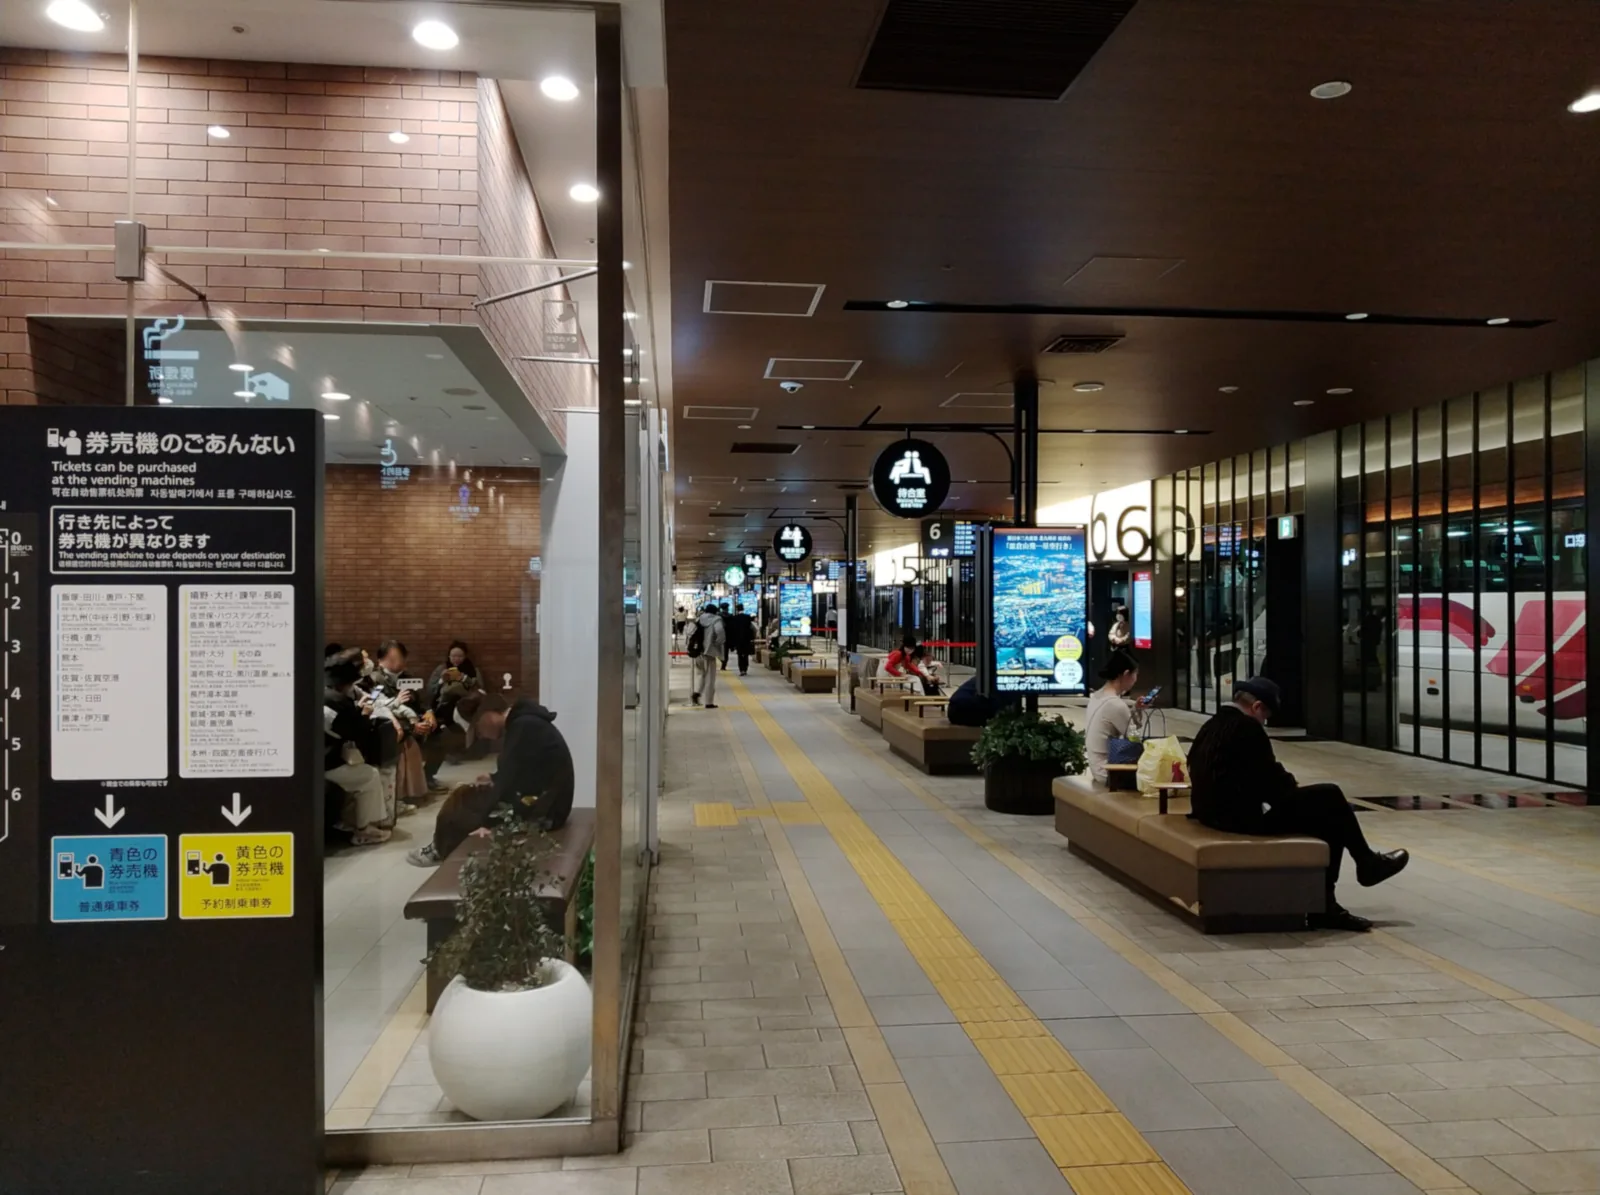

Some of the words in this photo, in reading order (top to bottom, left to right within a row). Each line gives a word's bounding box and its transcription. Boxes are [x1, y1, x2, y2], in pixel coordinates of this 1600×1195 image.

[86, 432, 295, 455] 券売機のごあんない
[52, 461, 92, 472] Tickets
[95, 464, 115, 472] can
[119, 461, 134, 472] be
[138, 461, 197, 474] purchased
[52, 476, 64, 485] at
[67, 474, 87, 484] the
[91, 475, 138, 487] vending
[142, 475, 195, 485] machines
[898, 488, 926, 498] 待合室
[58, 514, 174, 530] 行き先によって
[929, 523, 941, 540] 6
[1117, 505, 1152, 563] 6
[11, 532, 21, 545] 0
[58, 533, 210, 549] 券売機が異なります
[59, 551, 74, 559] The
[76, 551, 108, 561] vending
[110, 551, 144, 560] machine
[172, 551, 206, 562] depends
[208, 552, 219, 560] on
[220, 553, 239, 562] your
[240, 551, 286, 560] destination
[815, 561, 822, 571] 5
[12, 571, 20, 584] 1
[11, 596, 21, 609] 2
[11, 640, 21, 653] 3
[11, 687, 21, 699] 4
[11, 737, 21, 750] 5
[11, 787, 21, 800] 6
[110, 848, 158, 862] 青色の
[236, 845, 285, 860] 黄色の
[109, 864, 159, 879] 券売機
[236, 863, 285, 877] 券売機
[79, 899, 140, 913] 普通乗車券
[201, 898, 273, 910] 予約制乗車券
